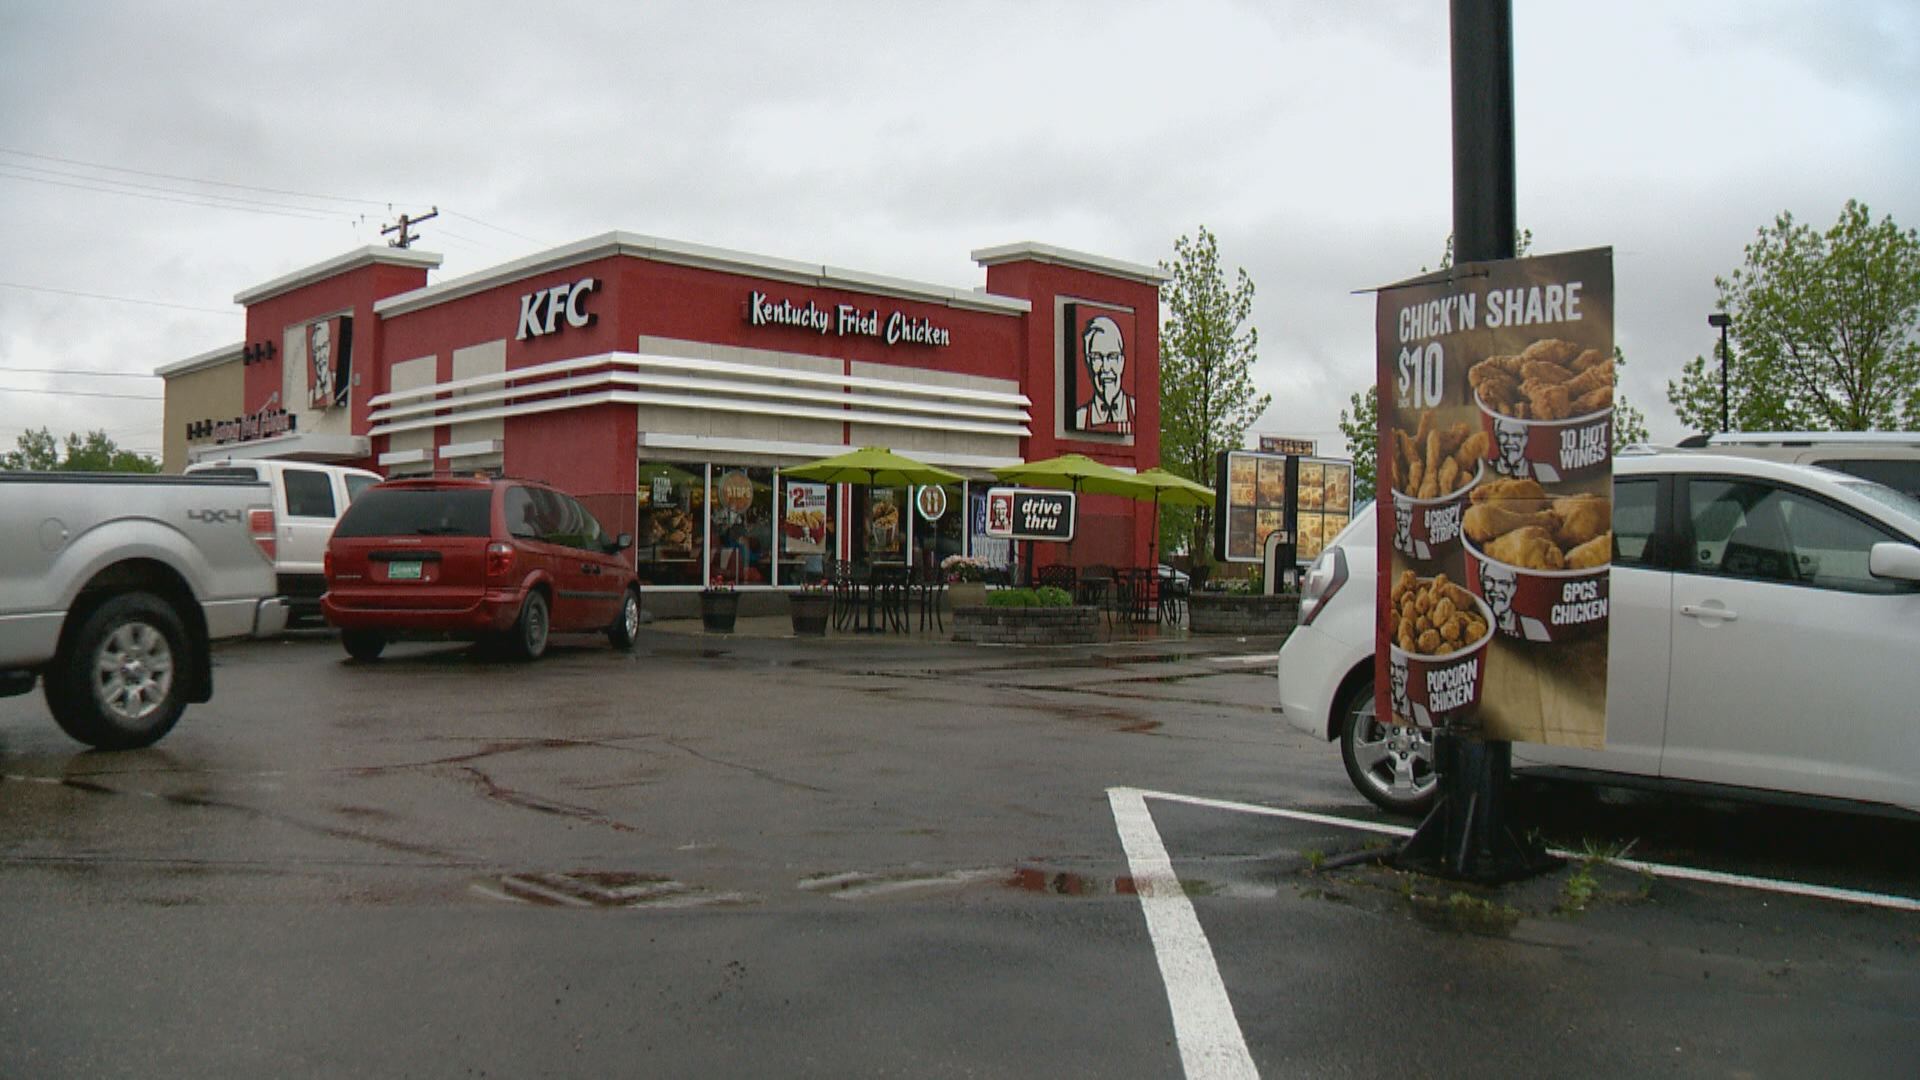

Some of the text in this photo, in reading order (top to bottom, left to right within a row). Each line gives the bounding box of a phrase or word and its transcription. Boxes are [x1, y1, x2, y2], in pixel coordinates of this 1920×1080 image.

[515, 278, 594, 341] KFC
[752, 290, 950, 346] Kentucky Fried Chicken
[1399, 281, 1582, 343] CHICK'N SHARE
[1398, 341, 1444, 409] $10
[1560, 422, 1608, 450] 10 HOT
[1560, 443, 1607, 470] WINGS
[1021, 498, 1062, 515] drive
[1430, 503, 1461, 528] CRISPY
[1024, 515, 1058, 530] thru
[1429, 522, 1460, 545] STRIPS
[1551, 598, 1608, 625] CHICKEN
[1427, 659, 1478, 692] POPCORN
[1429, 682, 1475, 713] CHICKEN
